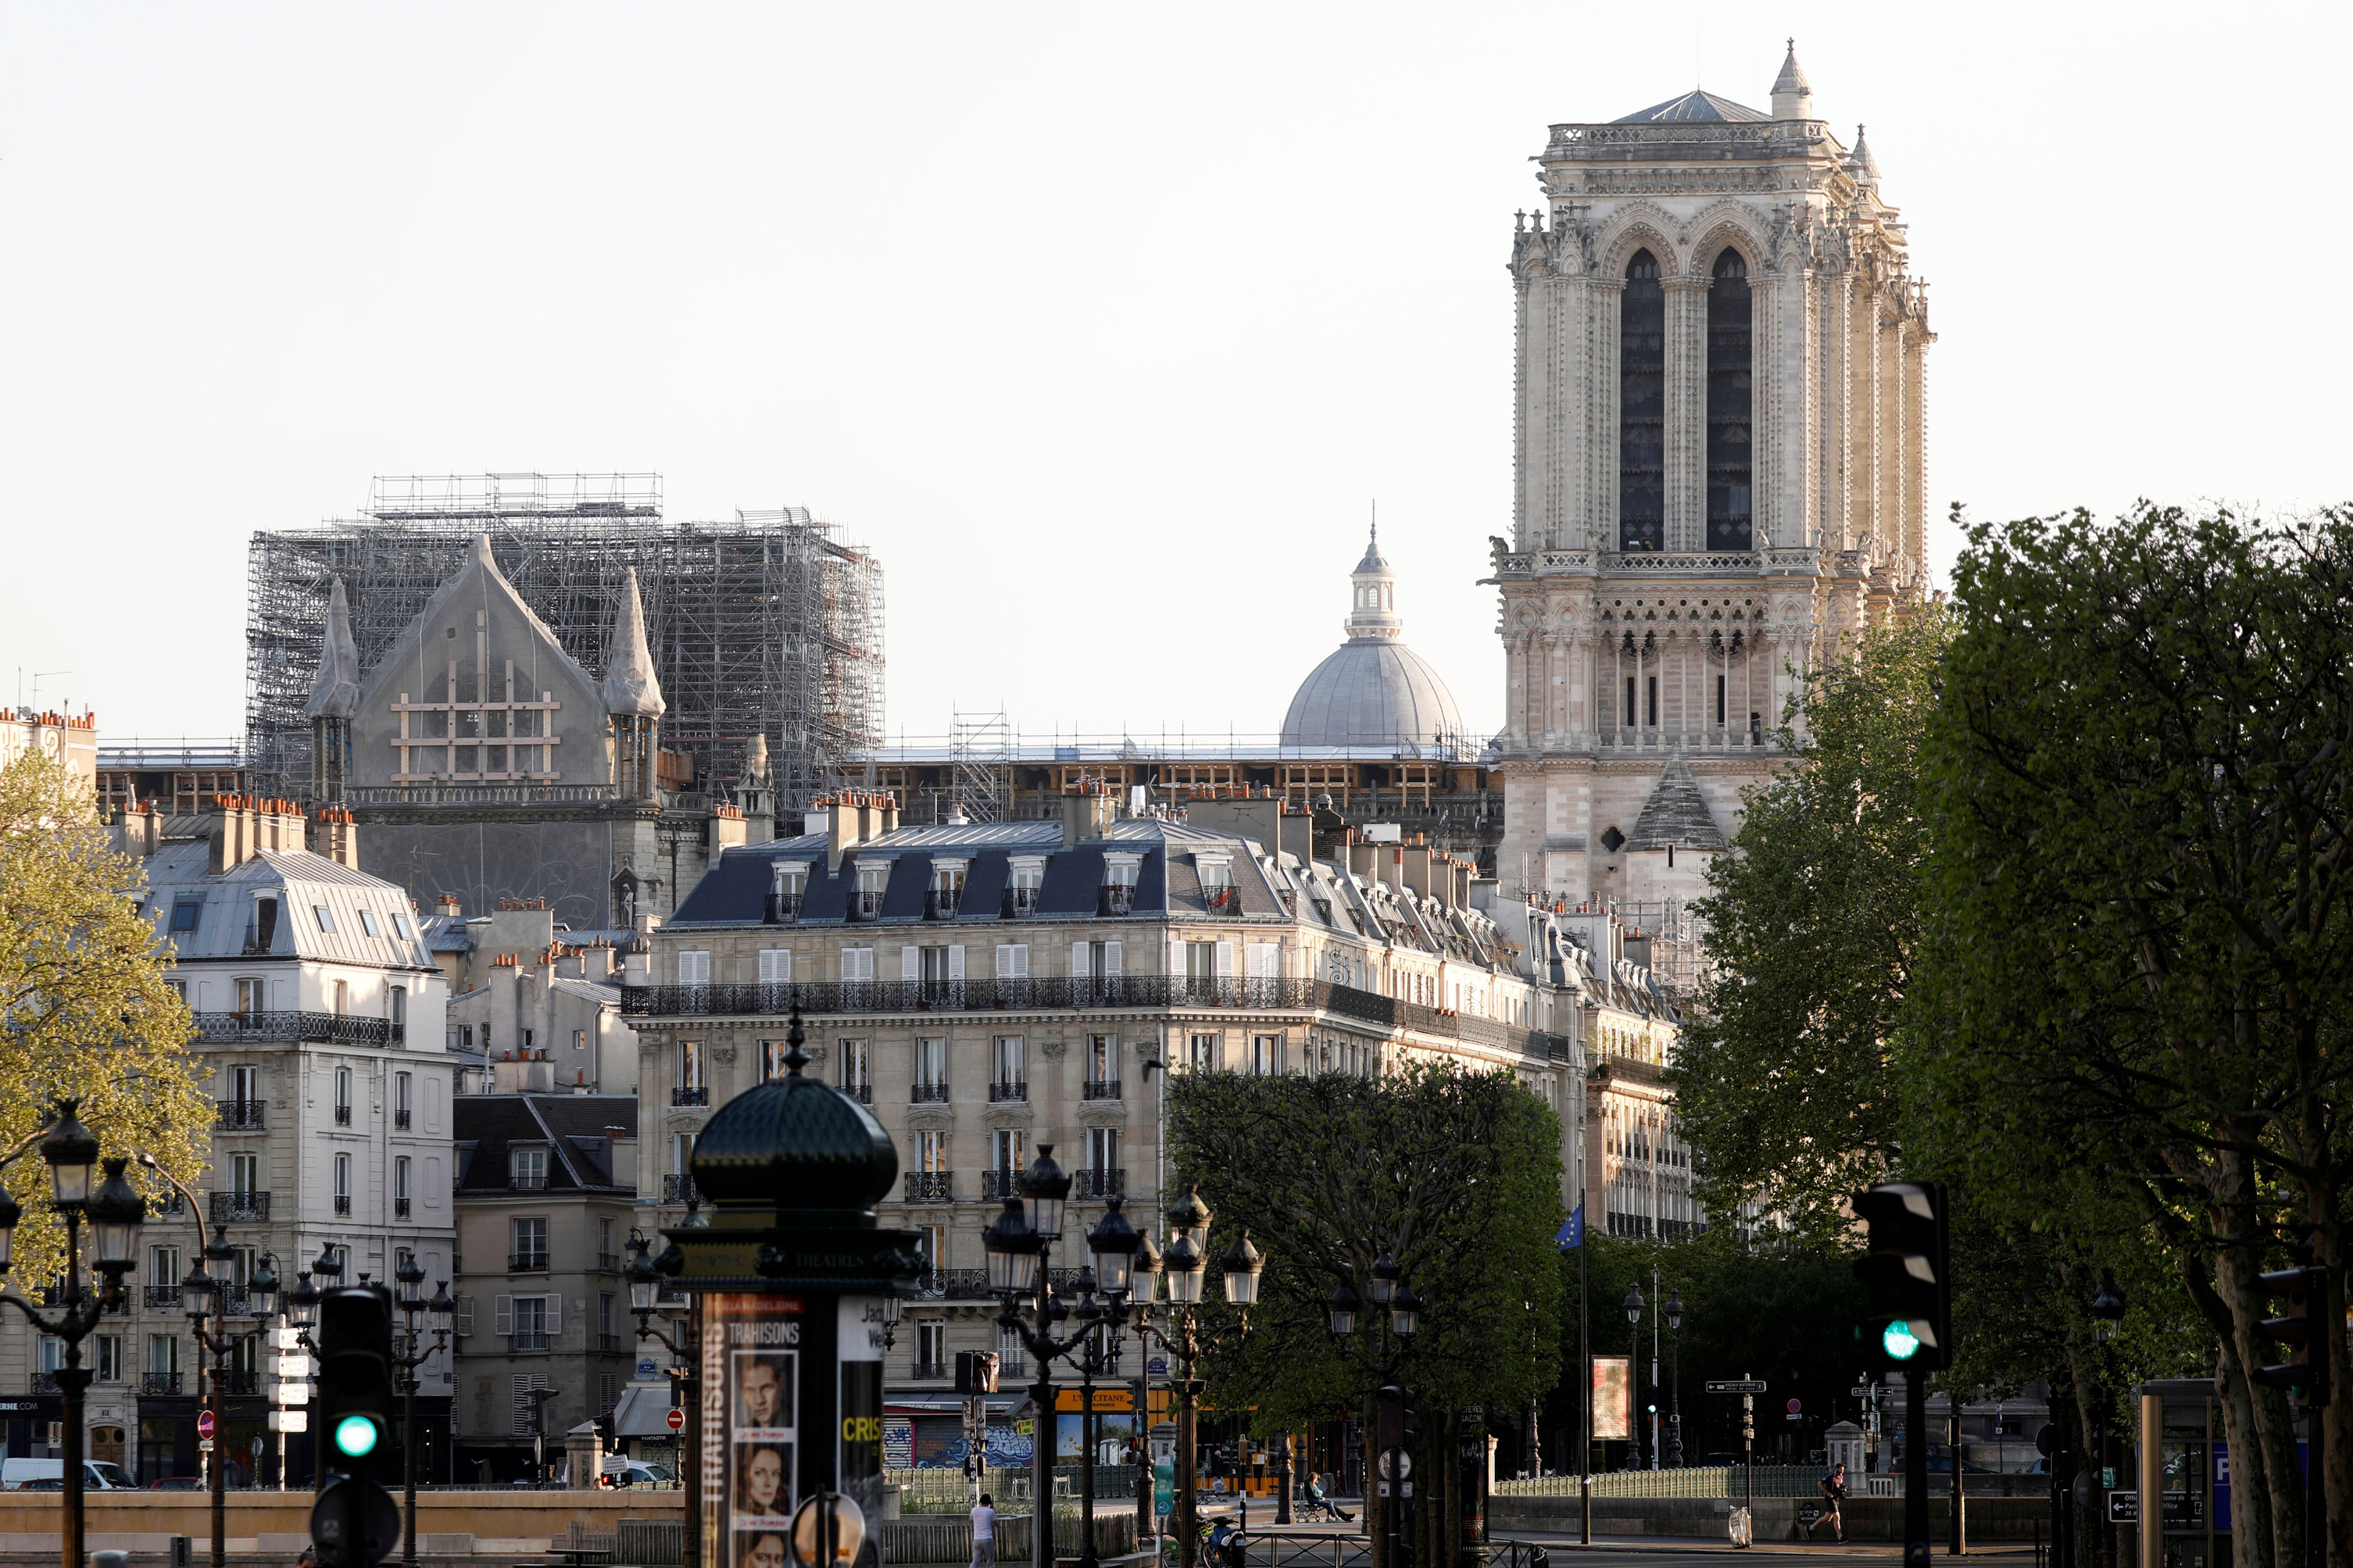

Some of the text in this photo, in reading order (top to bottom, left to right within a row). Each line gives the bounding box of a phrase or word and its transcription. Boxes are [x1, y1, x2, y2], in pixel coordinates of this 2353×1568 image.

[730, 1323, 800, 1345] TRAHISONS
[1072, 1394, 1125, 1402] L'OCITANE
[703, 1323, 724, 1502] TRAHISONS
[2217, 1458, 2230, 1480] P
